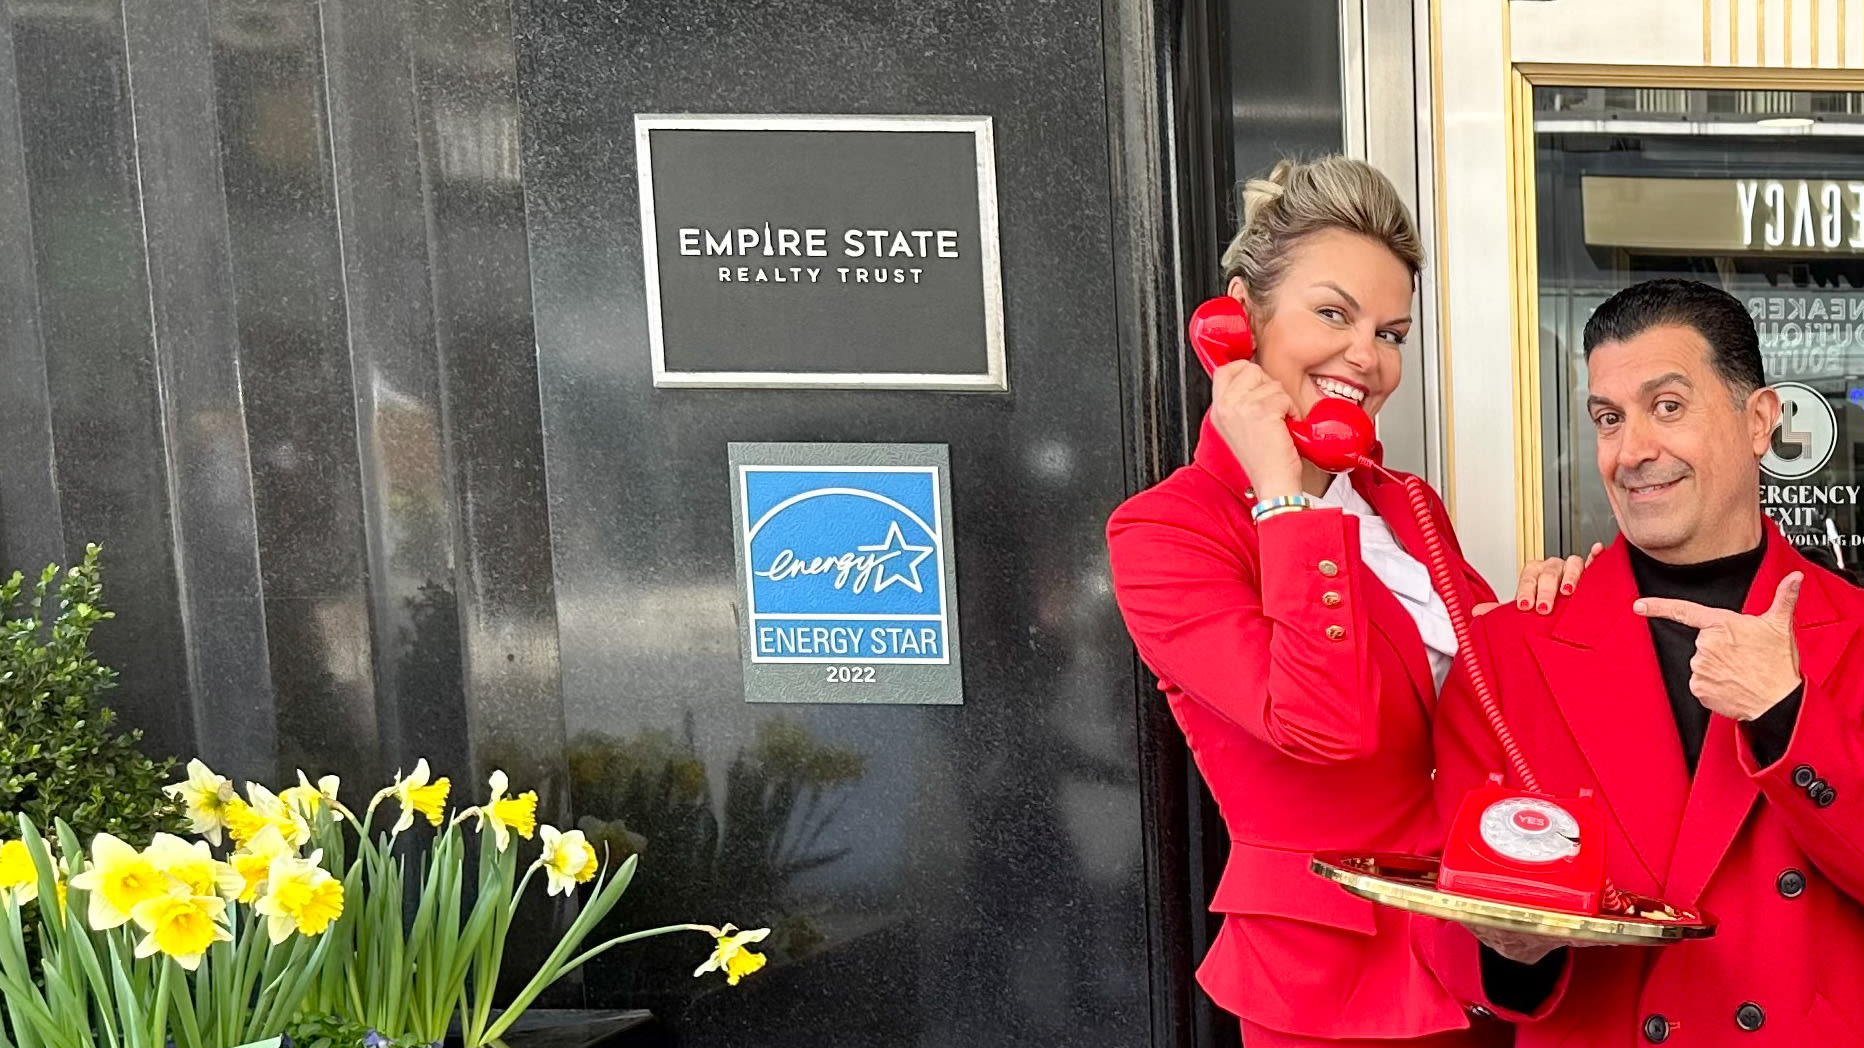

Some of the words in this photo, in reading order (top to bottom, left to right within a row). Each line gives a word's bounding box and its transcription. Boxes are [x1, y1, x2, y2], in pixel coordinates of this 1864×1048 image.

[679, 221, 828, 257] EMPIRE
[843, 228, 960, 258] STATE
[718, 266, 821, 283] REALTY
[837, 267, 923, 284] TRUST
[1759, 485, 1861, 504] ERGENCY
[1764, 507, 1816, 526] EXIT
[755, 549, 902, 594] energy
[760, 627, 863, 654] ENERGY
[870, 627, 938, 655] STAR
[826, 666, 876, 683] 2022
[1519, 815, 1544, 826] YES
